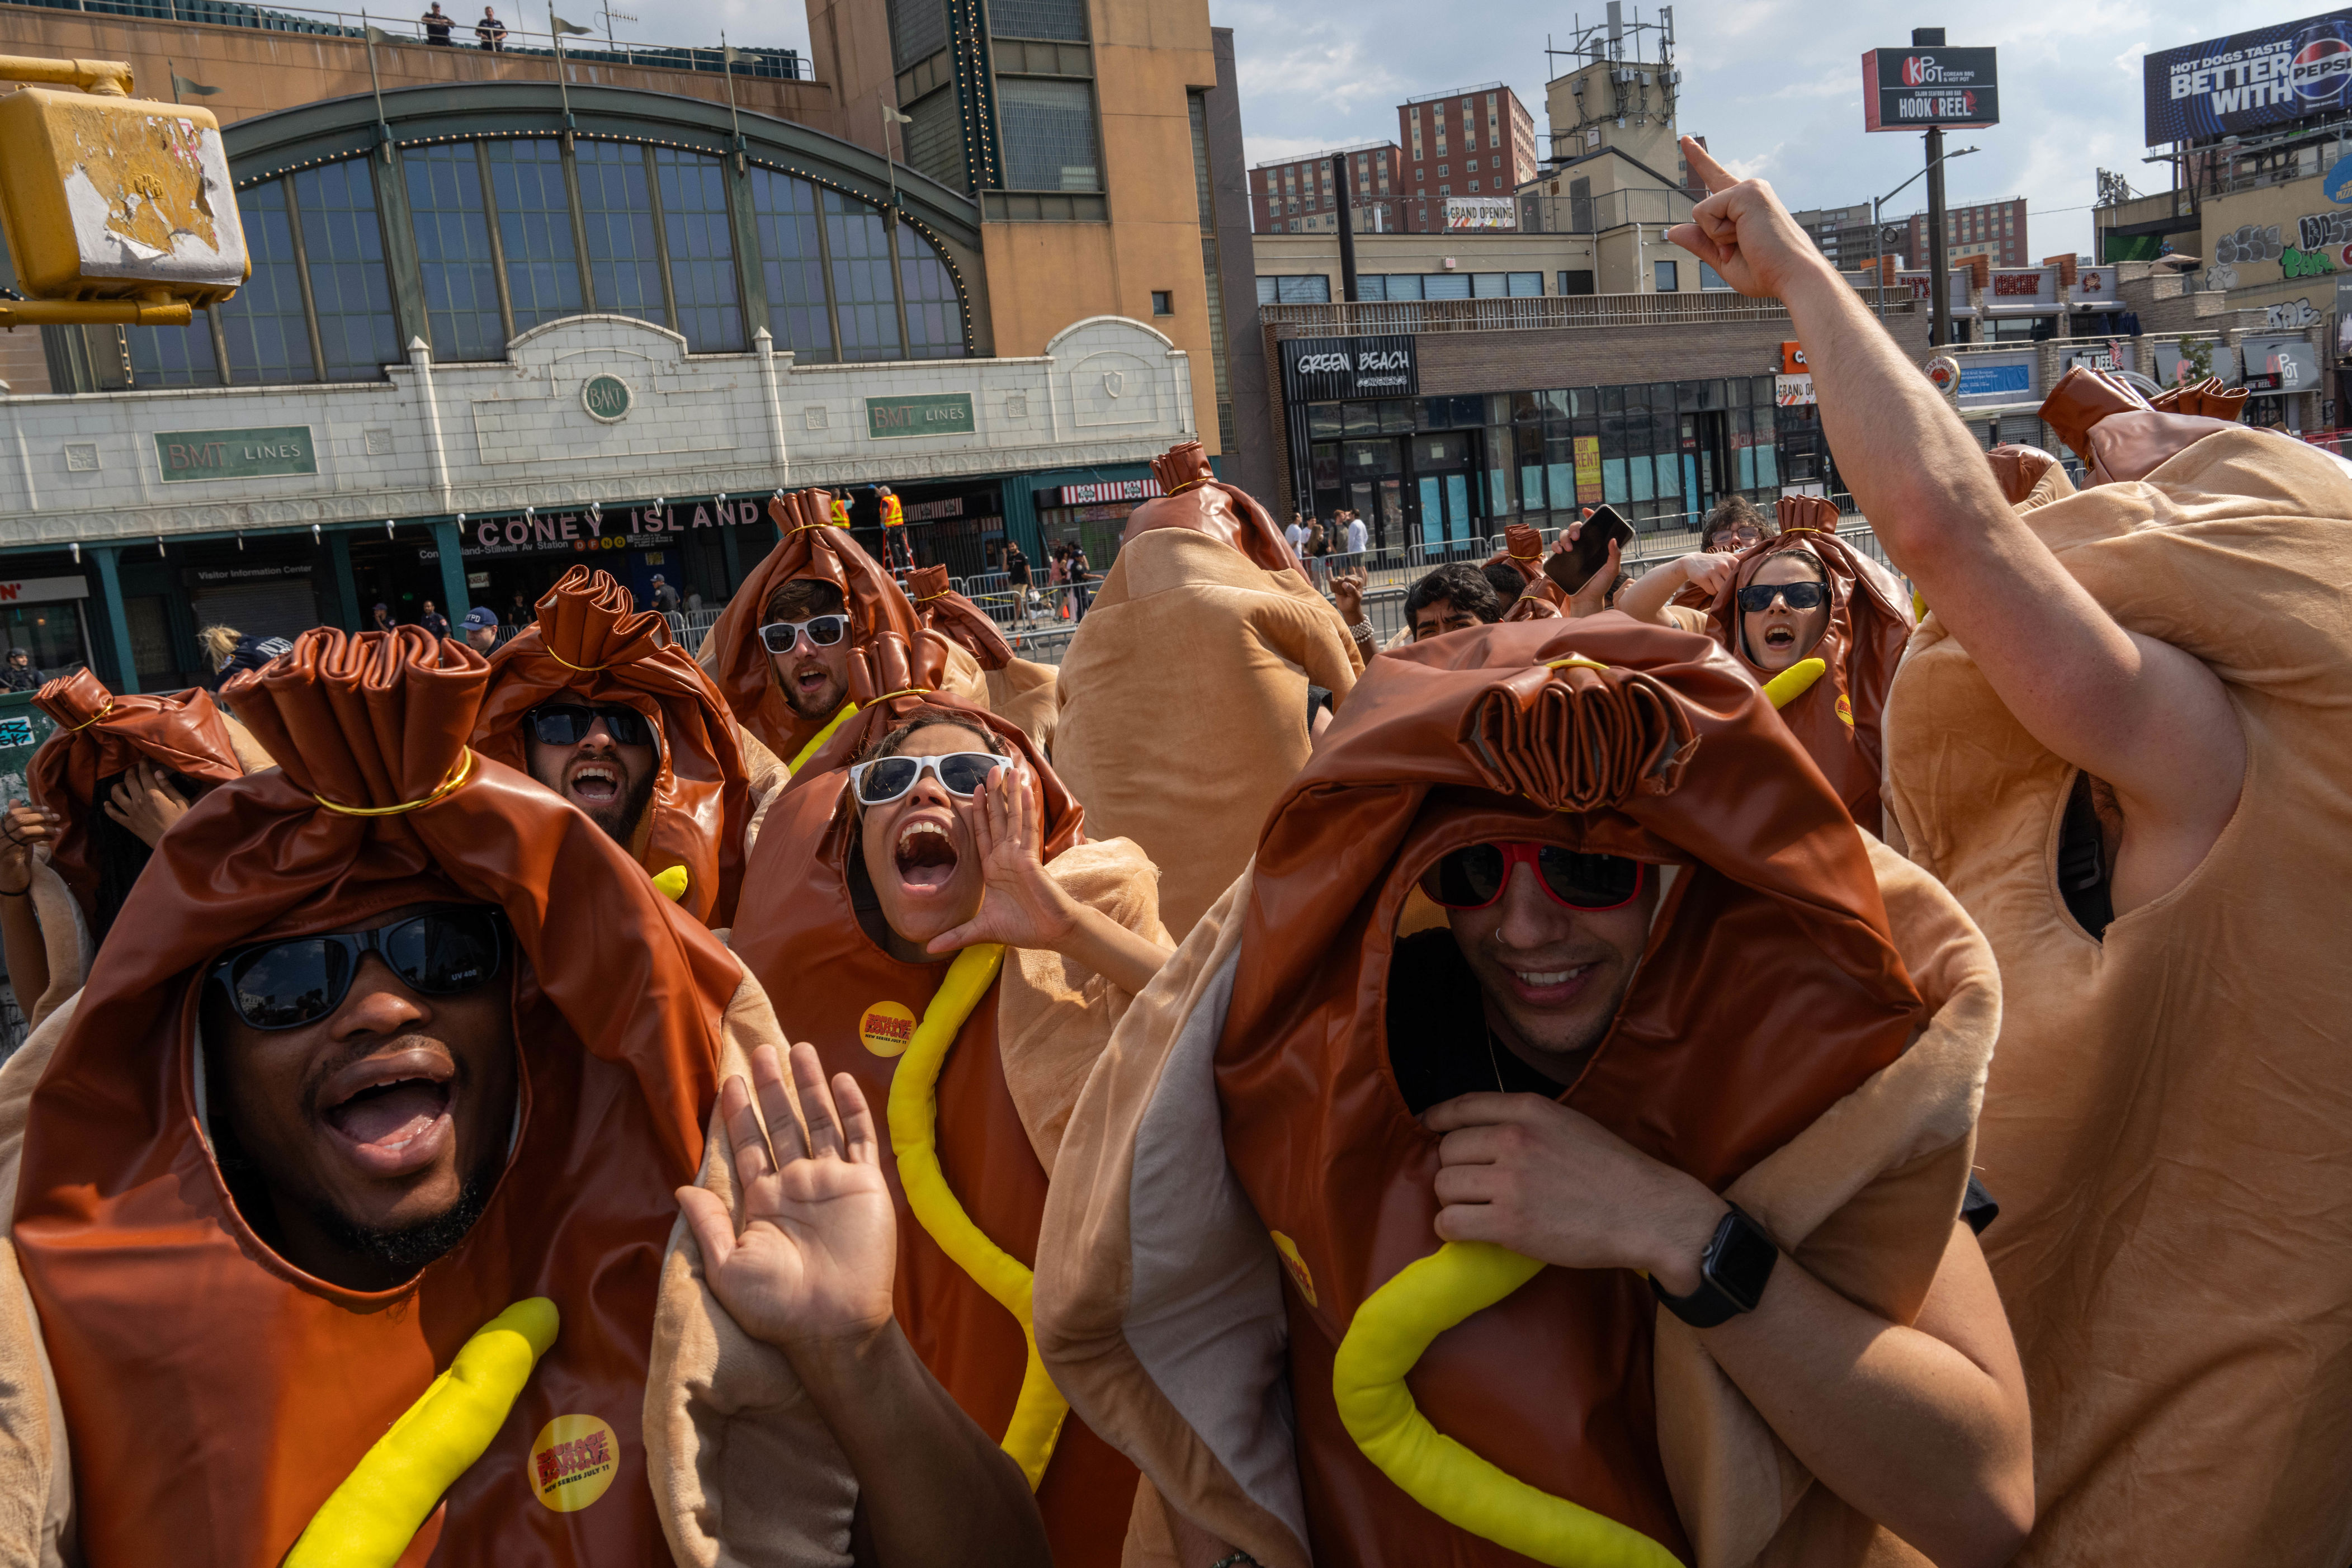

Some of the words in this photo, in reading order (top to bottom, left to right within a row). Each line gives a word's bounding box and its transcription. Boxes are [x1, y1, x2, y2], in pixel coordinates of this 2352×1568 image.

[2170, 60, 2200, 75] HOT
[2202, 51, 2243, 67] DOGS
[2245, 39, 2292, 58] TASTE
[2171, 53, 2292, 100] BETTER
[2293, 57, 2352, 80] PEPSI
[2212, 77, 2293, 116] WITH
[1899, 98, 1933, 117] HOOK
[1938, 97, 1972, 116] REEL
[1451, 207, 1477, 219] GRAND
[1480, 207, 1513, 219] OPENING
[1298, 353, 1350, 374] GREEN
[1358, 351, 1410, 371] BEACH
[1925, 361, 1936, 375] RAB
[1938, 359, 1956, 375] HOUSE
[2071, 356, 2091, 370] HOOK
[2095, 355, 2115, 370] REEL
[1356, 376, 1407, 387] CONVENIENCE
[1778, 384, 1803, 397] GRAND
[589, 384, 622, 410] BMT
[874, 406, 913, 428] BMT
[926, 408, 965, 421] LINES
[169, 442, 225, 470] BMT
[244, 445, 301, 460] LINES
[1574, 440, 1588, 452] FOR
[1575, 452, 1598, 467] RENT
[478, 514, 603, 546] CONEY
[631, 502, 759, 533] ISLAND
[420, 549, 439, 559] Con
[522, 542, 532, 551] Av
[537, 541, 568, 550] Station
[230, 567, 281, 578] Information
[284, 565, 312, 573] Center
[451, 972, 462, 981] UV
[464, 969, 477, 977] 400
[867, 1013, 912, 1027] SAUSAGE
[536, 1430, 607, 1465] SAUSAGE
[545, 1482, 557, 1494] NEW
[558, 1474, 582, 1487] SERIES
[583, 1467, 600, 1479] JULY
